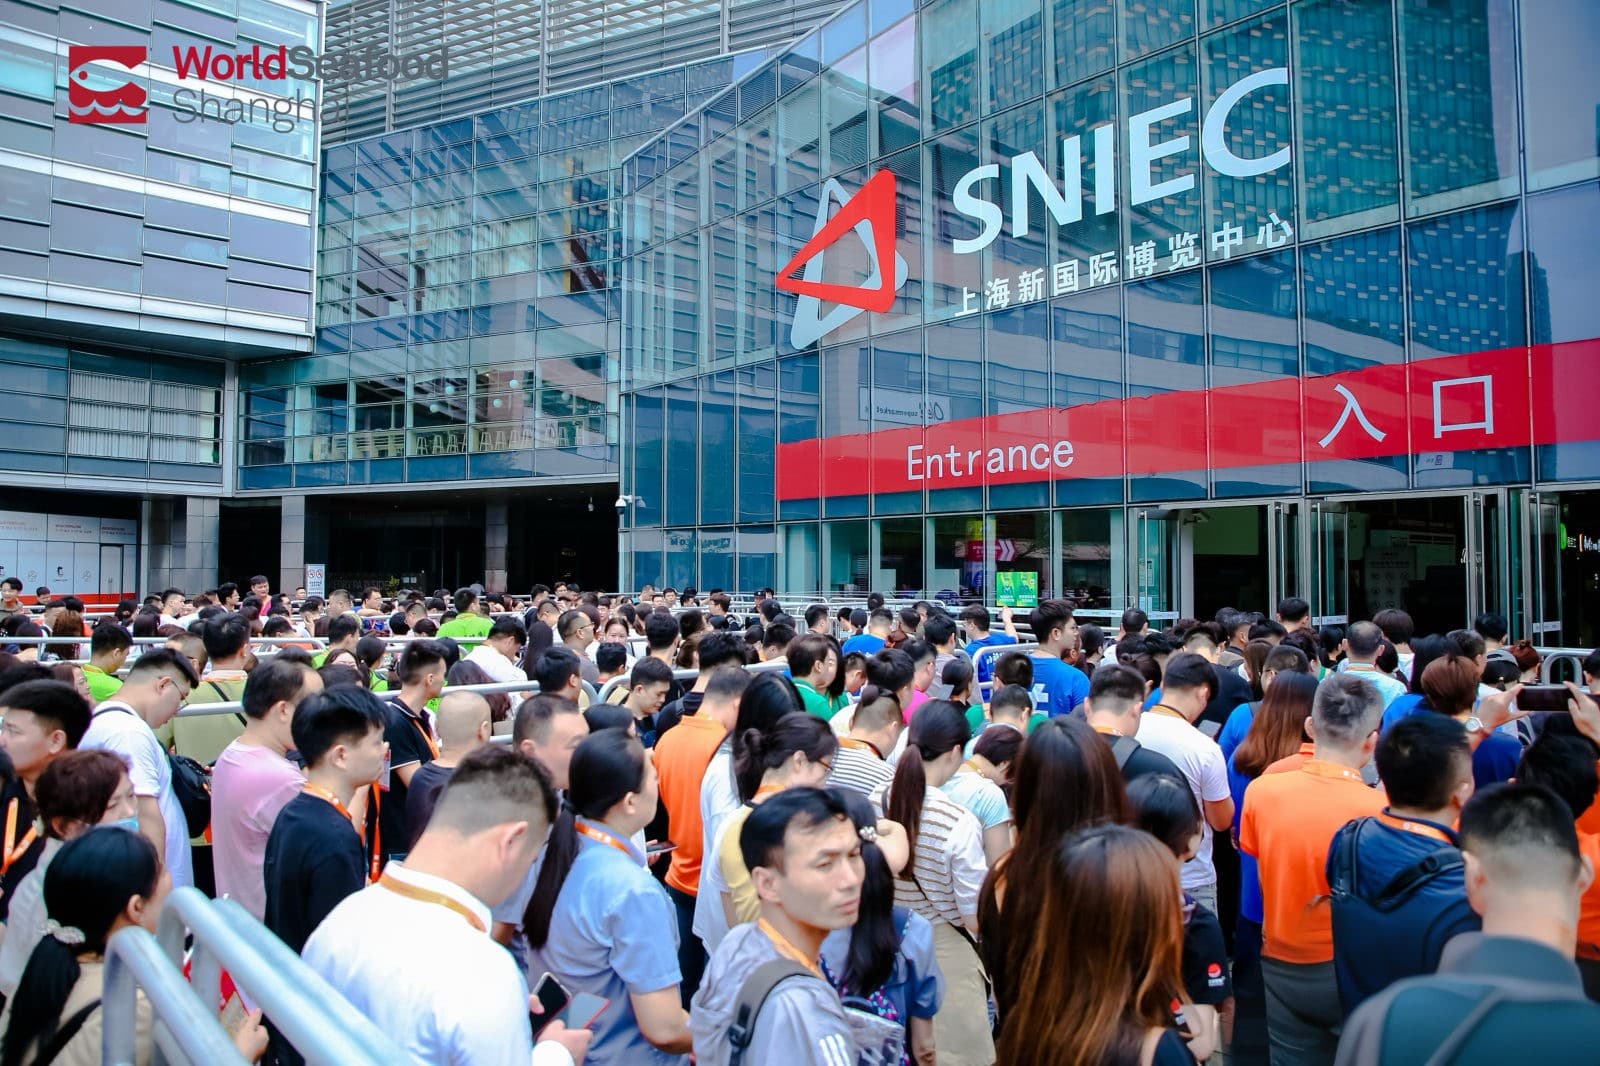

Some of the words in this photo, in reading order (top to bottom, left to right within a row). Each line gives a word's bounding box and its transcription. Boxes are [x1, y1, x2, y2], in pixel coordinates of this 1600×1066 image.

[952, 66, 1291, 255] SNIEC
[953, 212, 1294, 318] 上海新国际博览中心
[1318, 374, 1495, 449] 入口
[906, 439, 1075, 482] Entrance
